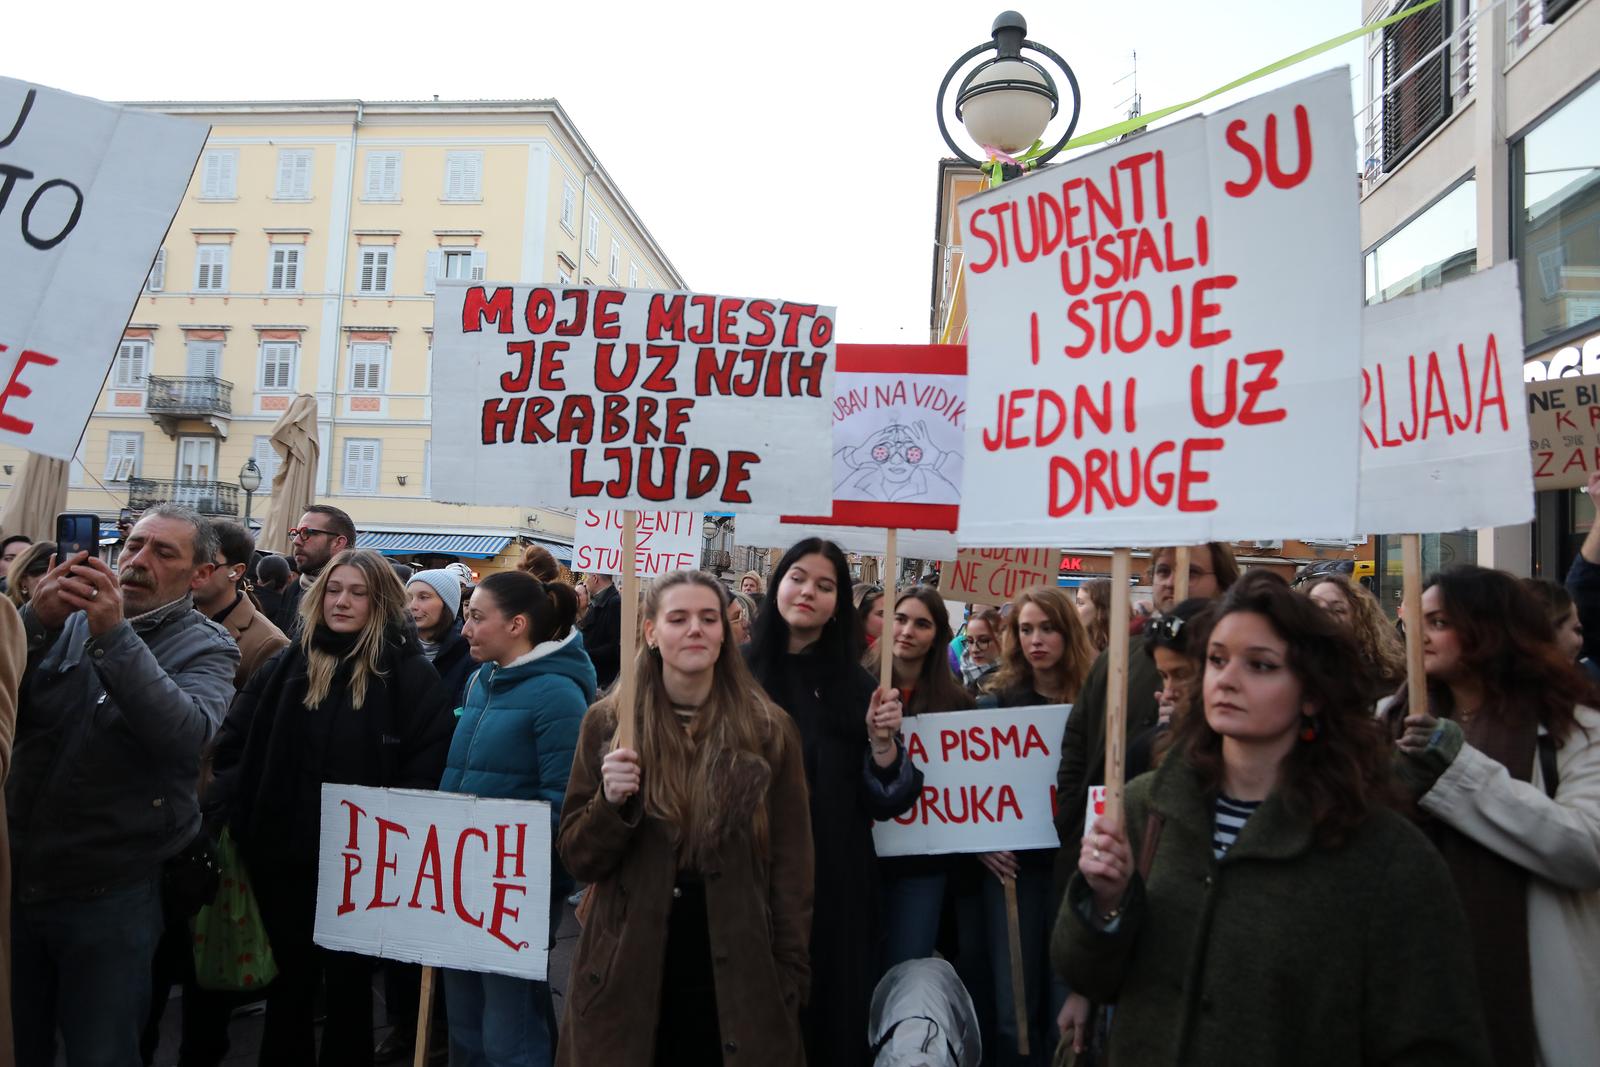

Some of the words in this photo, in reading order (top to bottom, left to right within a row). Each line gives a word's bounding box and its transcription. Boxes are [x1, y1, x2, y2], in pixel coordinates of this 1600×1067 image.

[968, 149, 1167, 273] STUDENTI
[1224, 104, 1312, 198] SU
[1060, 216, 1208, 295] USTALI
[462, 286, 626, 339] MOJE
[646, 294, 832, 348] MJESTO
[1031, 312, 1039, 365] I
[1064, 275, 1238, 359] STOJE
[500, 341, 570, 393] JE
[593, 343, 680, 393] UZ
[695, 347, 827, 398] NJIH
[482, 395, 695, 445] HRABRE
[832, 386, 868, 426] UBAV
[875, 380, 906, 408] NA
[913, 382, 966, 432] VIDIK
[983, 377, 1136, 452] JEDNI
[1191, 349, 1287, 428] UZ
[570, 447, 761, 503] LJUDE
[1048, 438, 1224, 518] DRUGE
[577, 545, 694, 573] STUENTE
[950, 560, 982, 592] NE
[957, 548, 1049, 568] UDENTI
[901, 733, 928, 763] A
[940, 724, 1050, 762] PISMA
[868, 785, 1023, 828] RUKA
